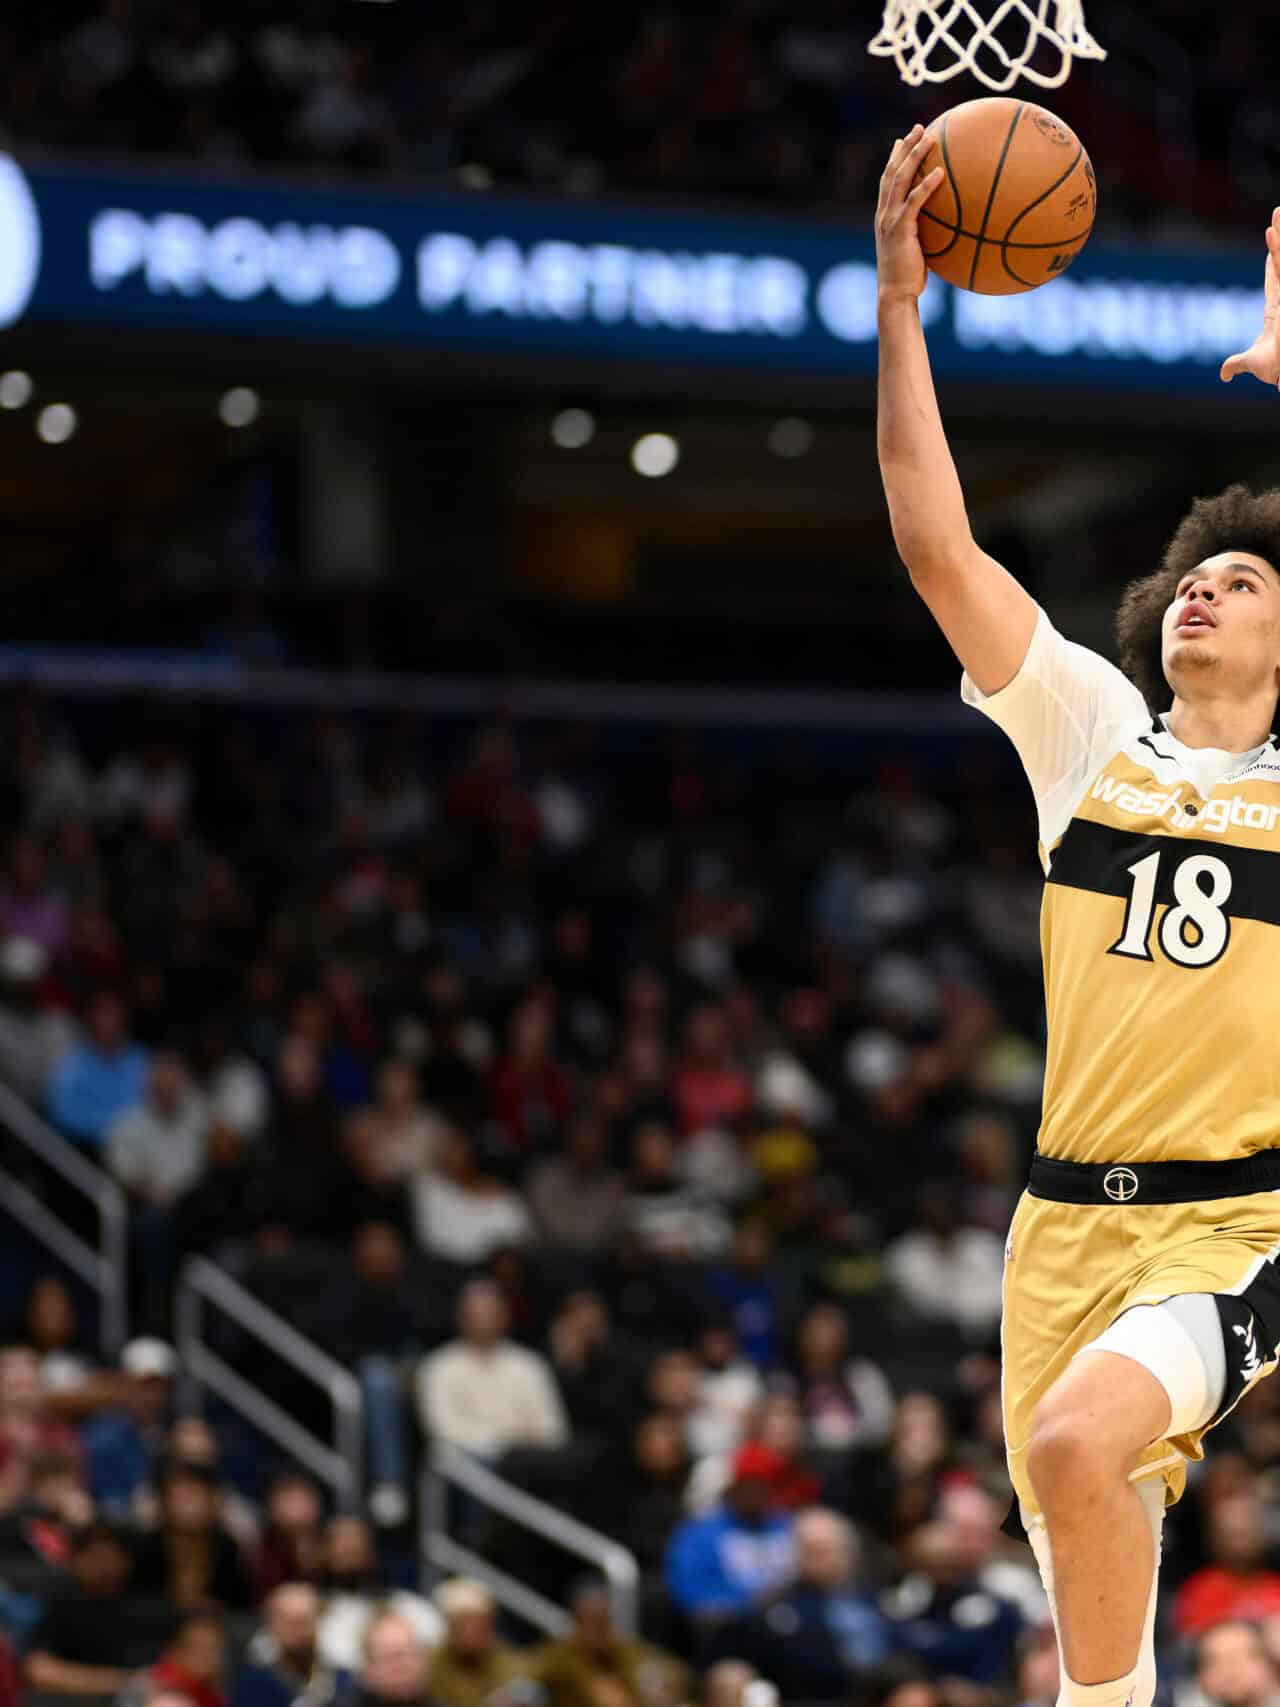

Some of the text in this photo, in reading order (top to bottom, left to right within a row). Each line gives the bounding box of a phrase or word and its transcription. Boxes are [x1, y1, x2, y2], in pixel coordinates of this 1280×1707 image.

[89, 209, 400, 308] PROUD
[415, 232, 808, 336] PARTNER
[1106, 850, 1233, 970] 18
